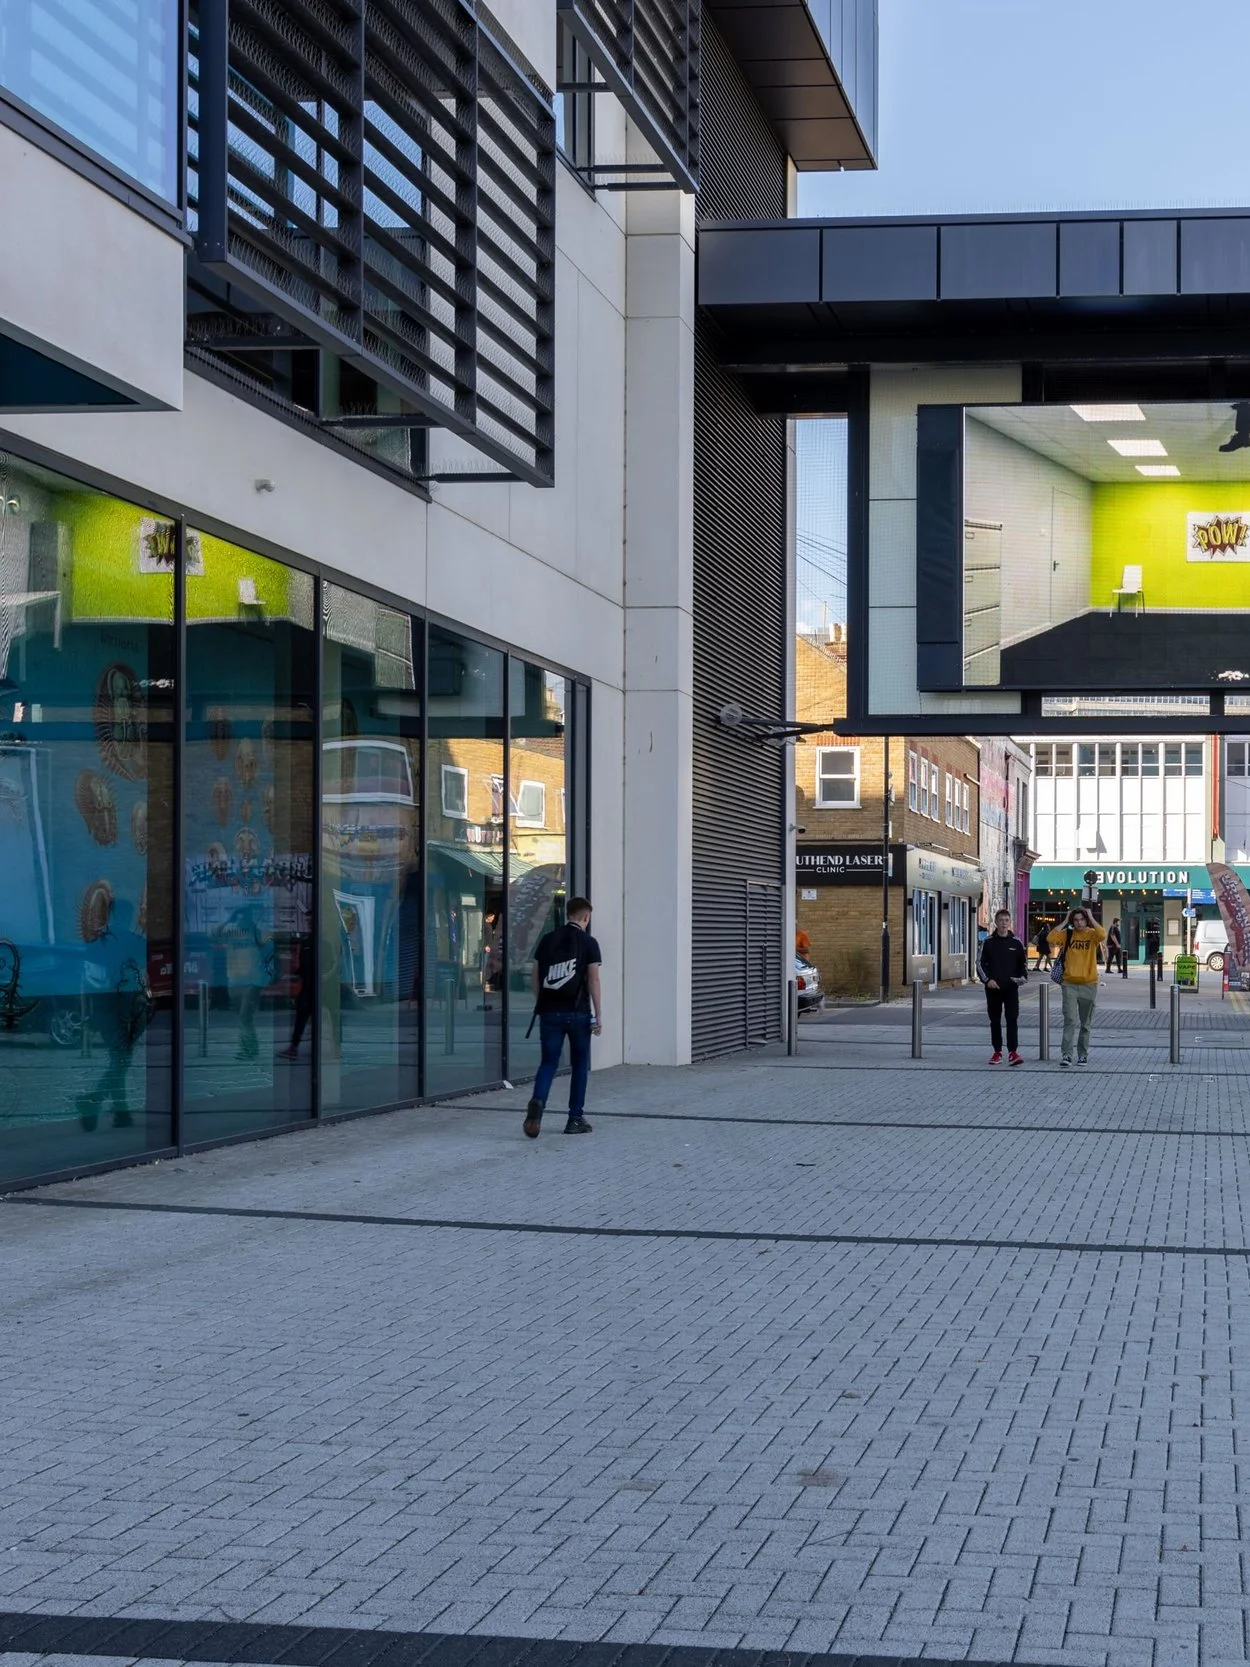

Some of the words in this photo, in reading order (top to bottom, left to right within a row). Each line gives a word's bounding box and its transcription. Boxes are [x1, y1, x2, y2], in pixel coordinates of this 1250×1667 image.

[1197, 522, 1248, 553] POW!
[796, 855, 843, 866] UTHEND
[846, 855, 884, 866] LASER
[1085, 871, 1189, 884] EVOLUTION
[547, 958, 577, 981] NIKE
